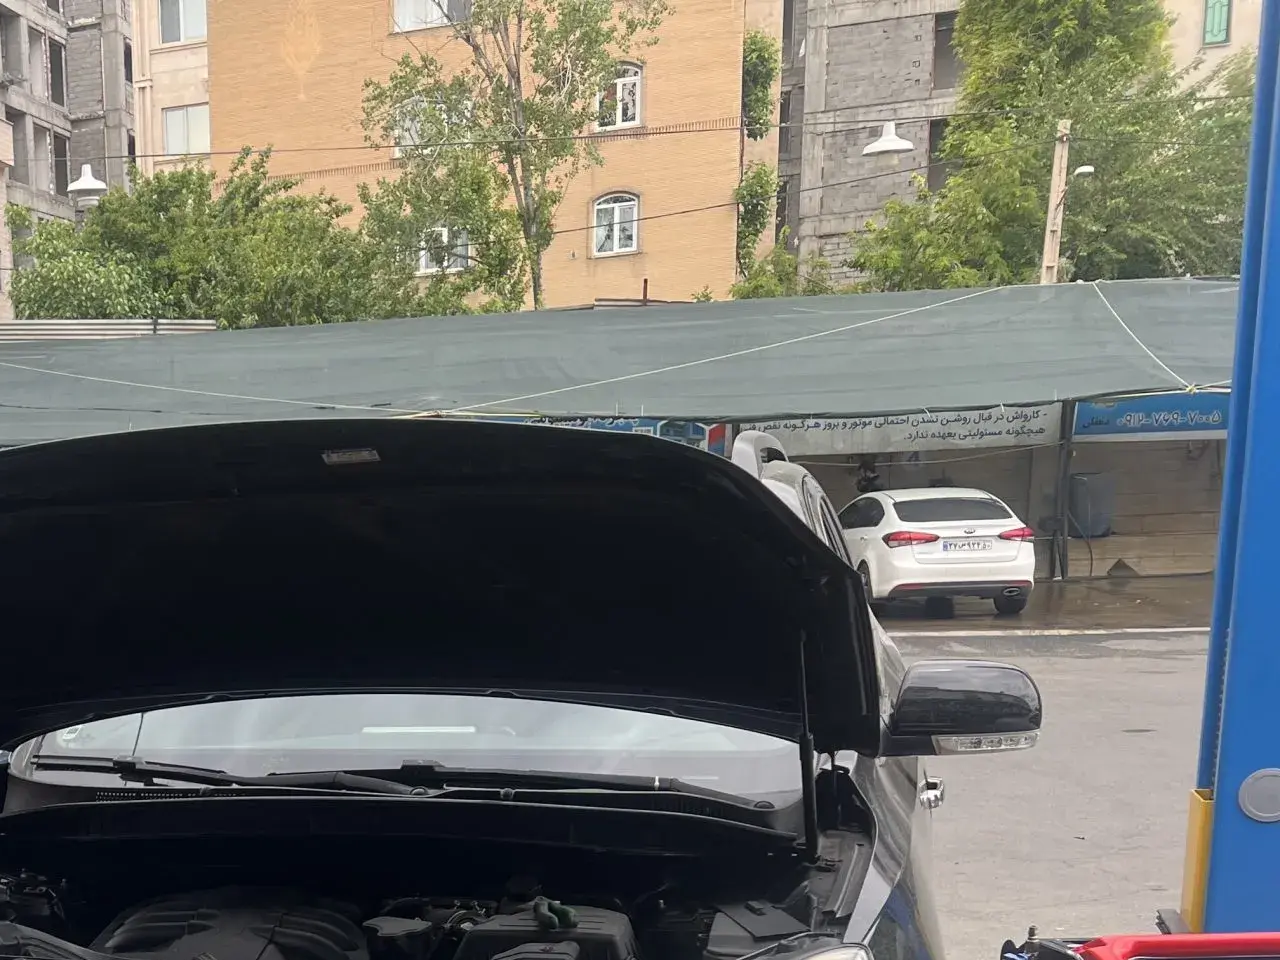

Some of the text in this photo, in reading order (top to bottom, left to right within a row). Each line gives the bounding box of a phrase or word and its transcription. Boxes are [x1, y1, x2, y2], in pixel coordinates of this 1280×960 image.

[873, 415, 910, 429] احتمالی
[911, 414, 939, 427] نشدن
[940, 413, 971, 426] روشن
[972, 411, 993, 425] قبال
[993, 413, 1005, 425] در
[1006, 409, 1041, 423] کارواش
[822, 420, 840, 432] بروز
[840, 421, 847, 430] و
[848, 419, 873, 431] موتور
[1005, 425, 1046, 436] هیچگونه
